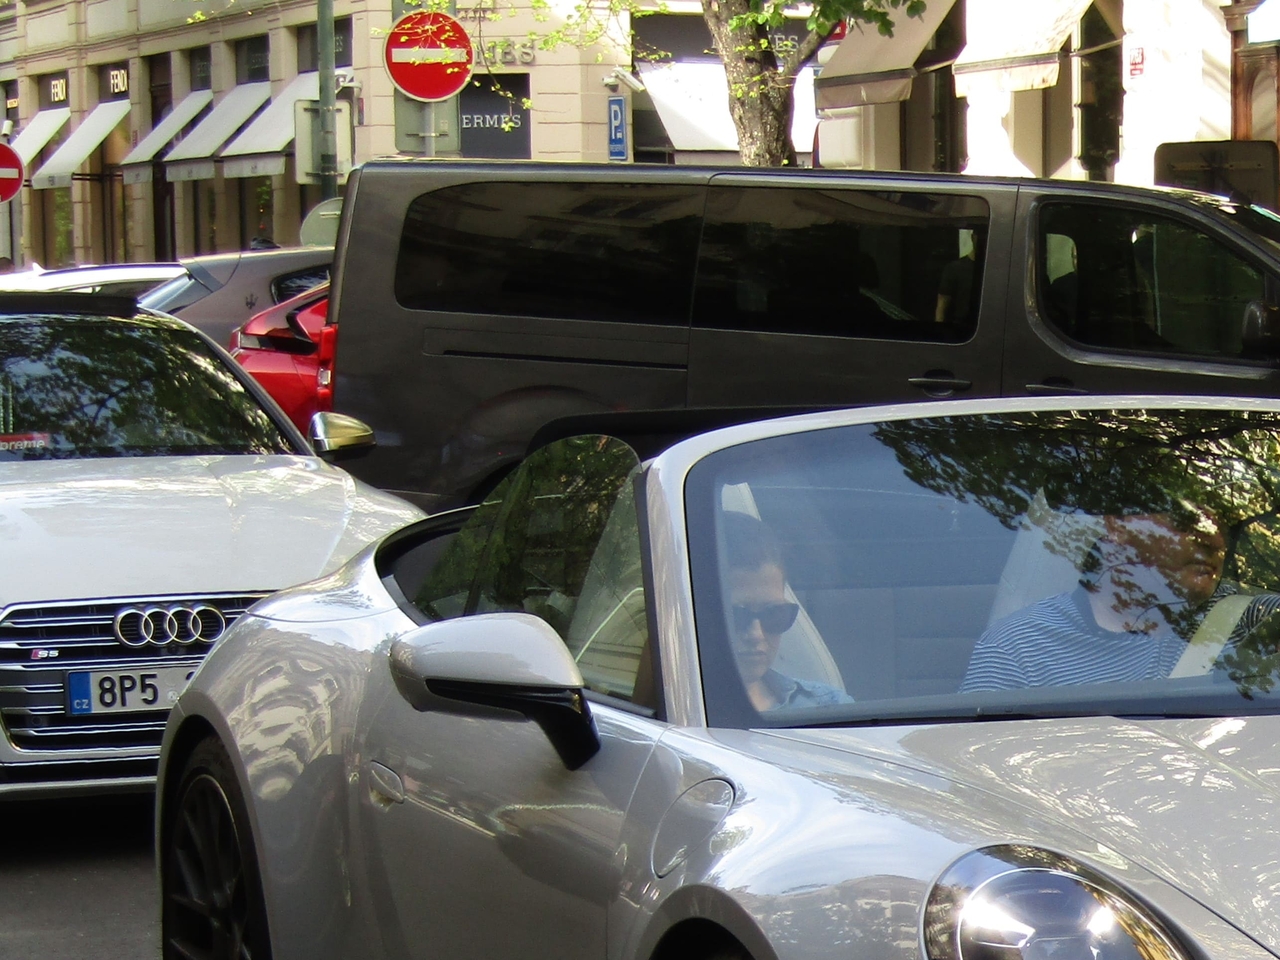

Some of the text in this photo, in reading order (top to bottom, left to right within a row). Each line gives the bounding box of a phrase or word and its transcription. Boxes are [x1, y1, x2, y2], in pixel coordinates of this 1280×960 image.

[51, 79, 67, 102] FENDI
[110, 69, 128, 93] FENDI
[611, 104, 621, 139] P
[37, 649, 59, 658] S5
[73, 699, 89, 709] CZ
[98, 674, 159, 708] 8P5
